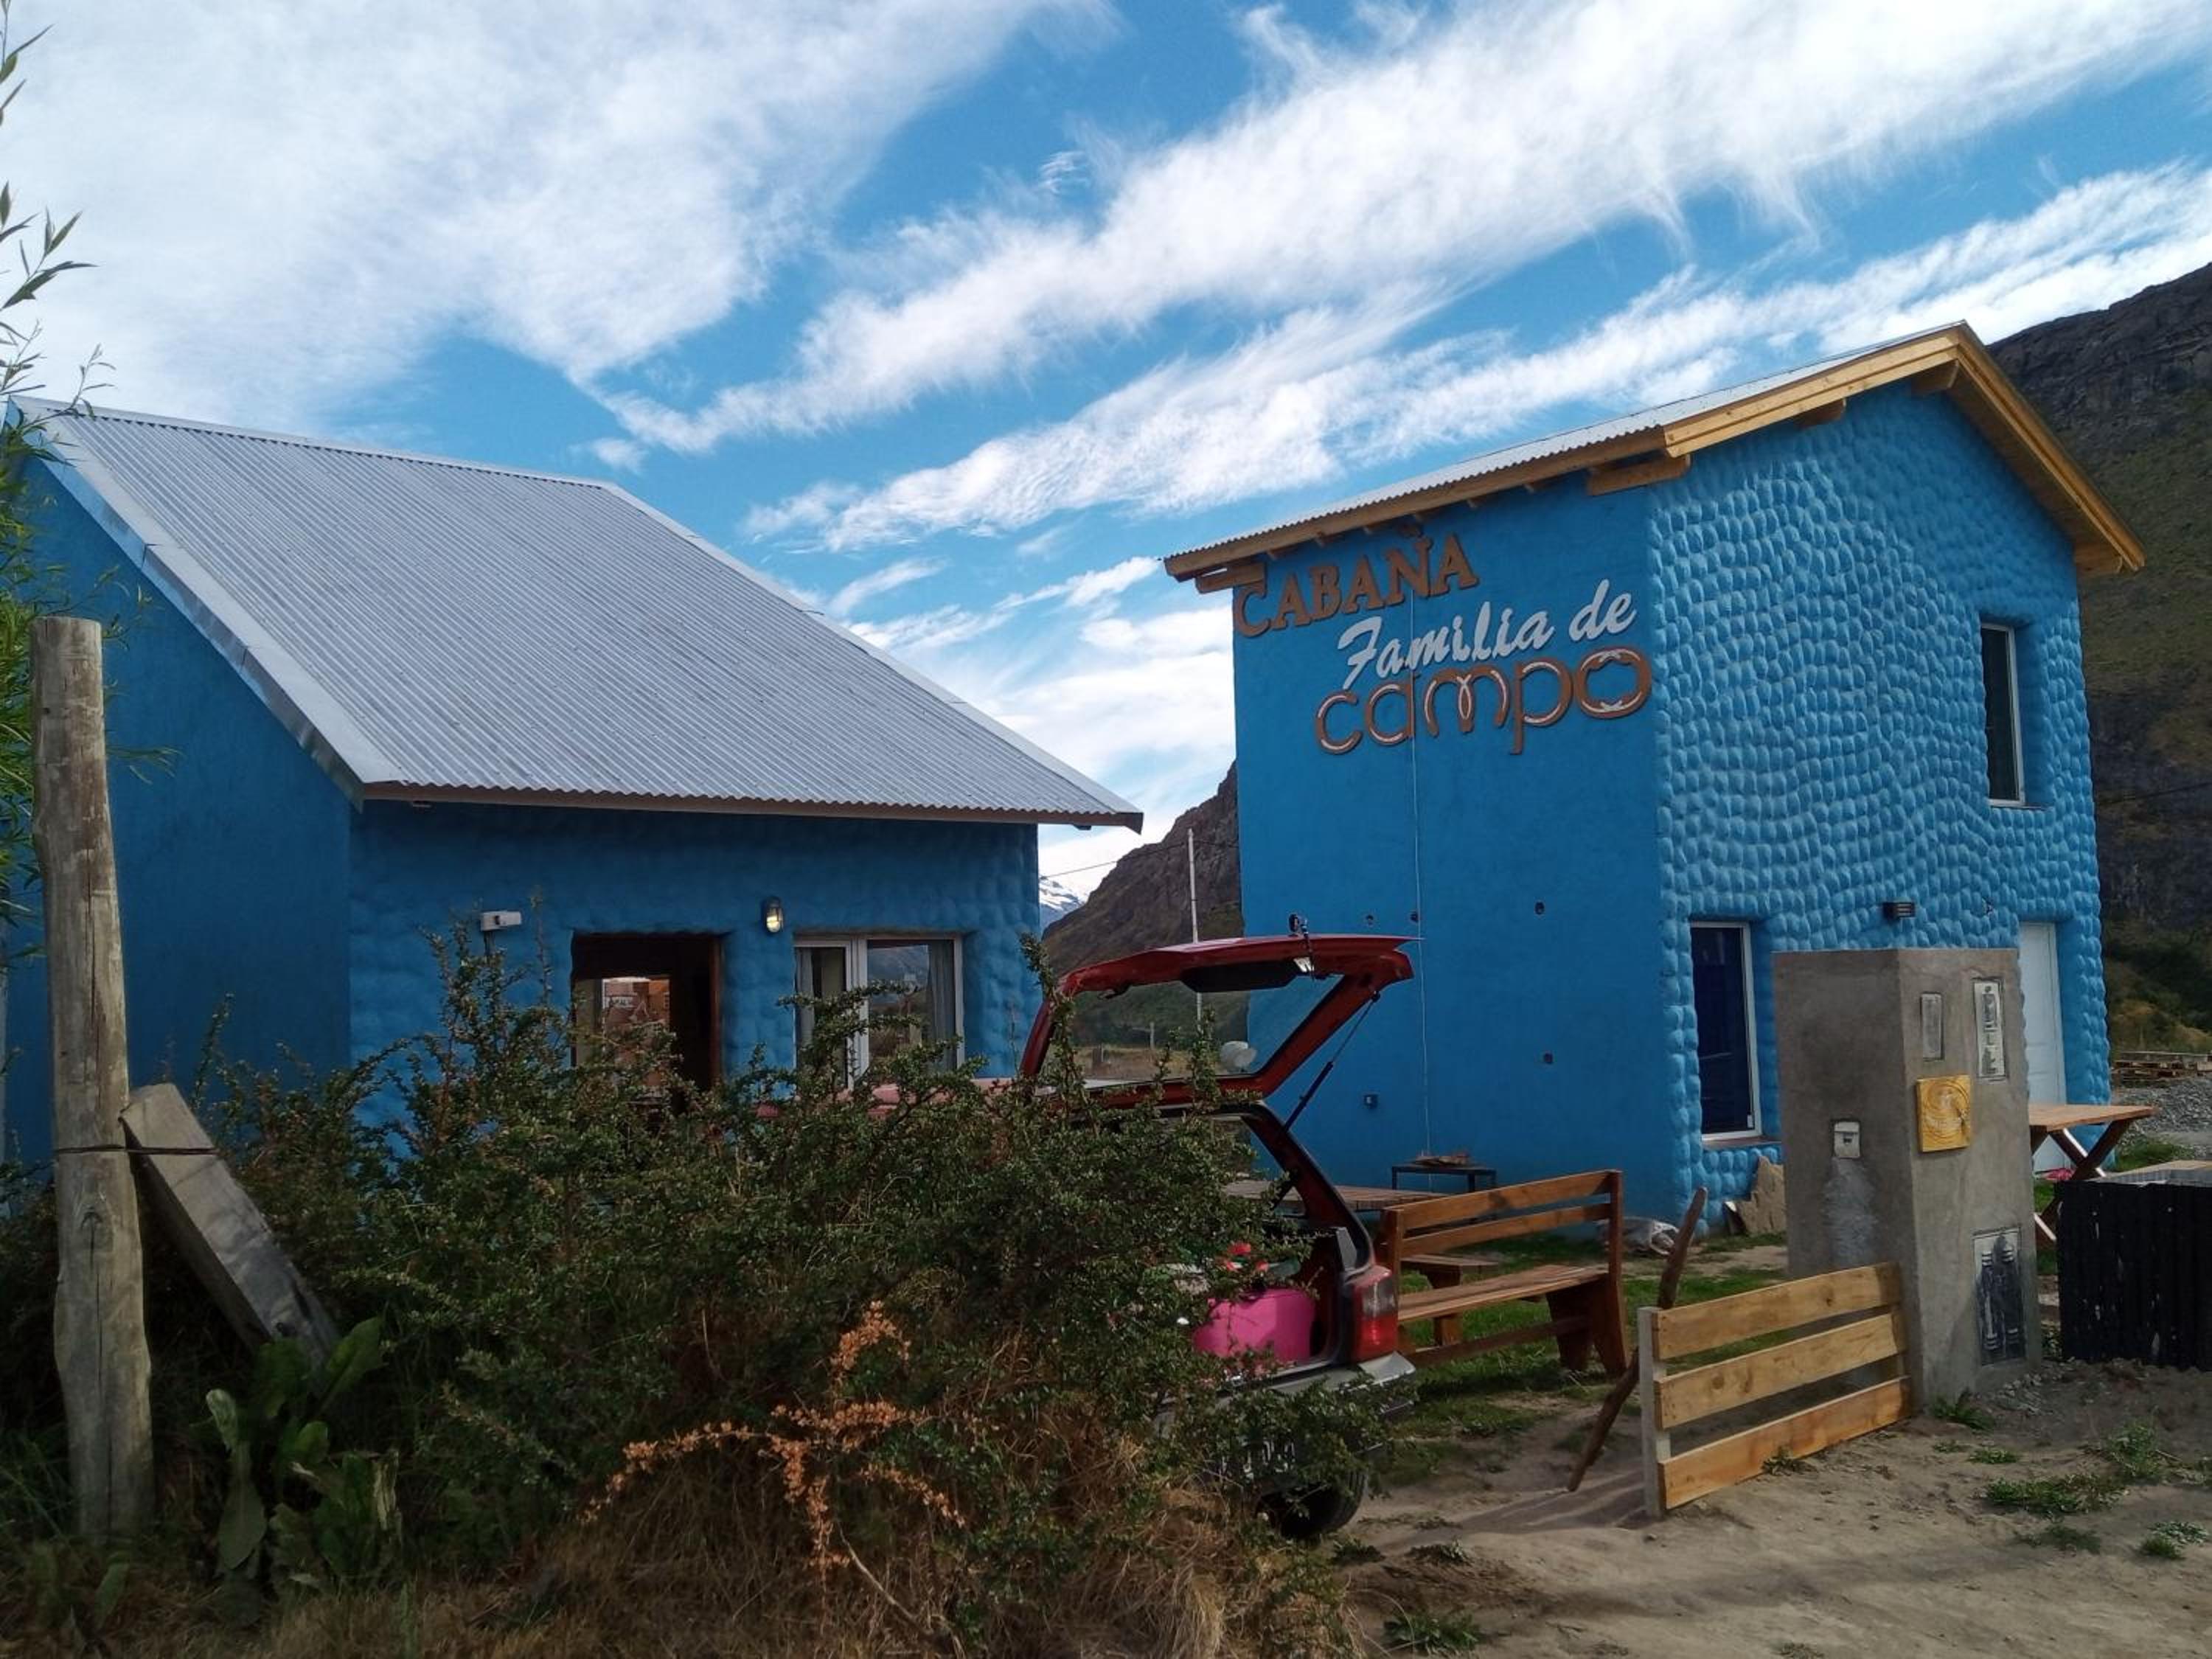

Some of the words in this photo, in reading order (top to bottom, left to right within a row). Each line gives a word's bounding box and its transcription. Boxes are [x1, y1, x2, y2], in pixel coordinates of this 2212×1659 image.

[1337, 601, 1554, 689] Familia
[1568, 579, 1637, 640] de
[1315, 646, 1652, 756] campo
